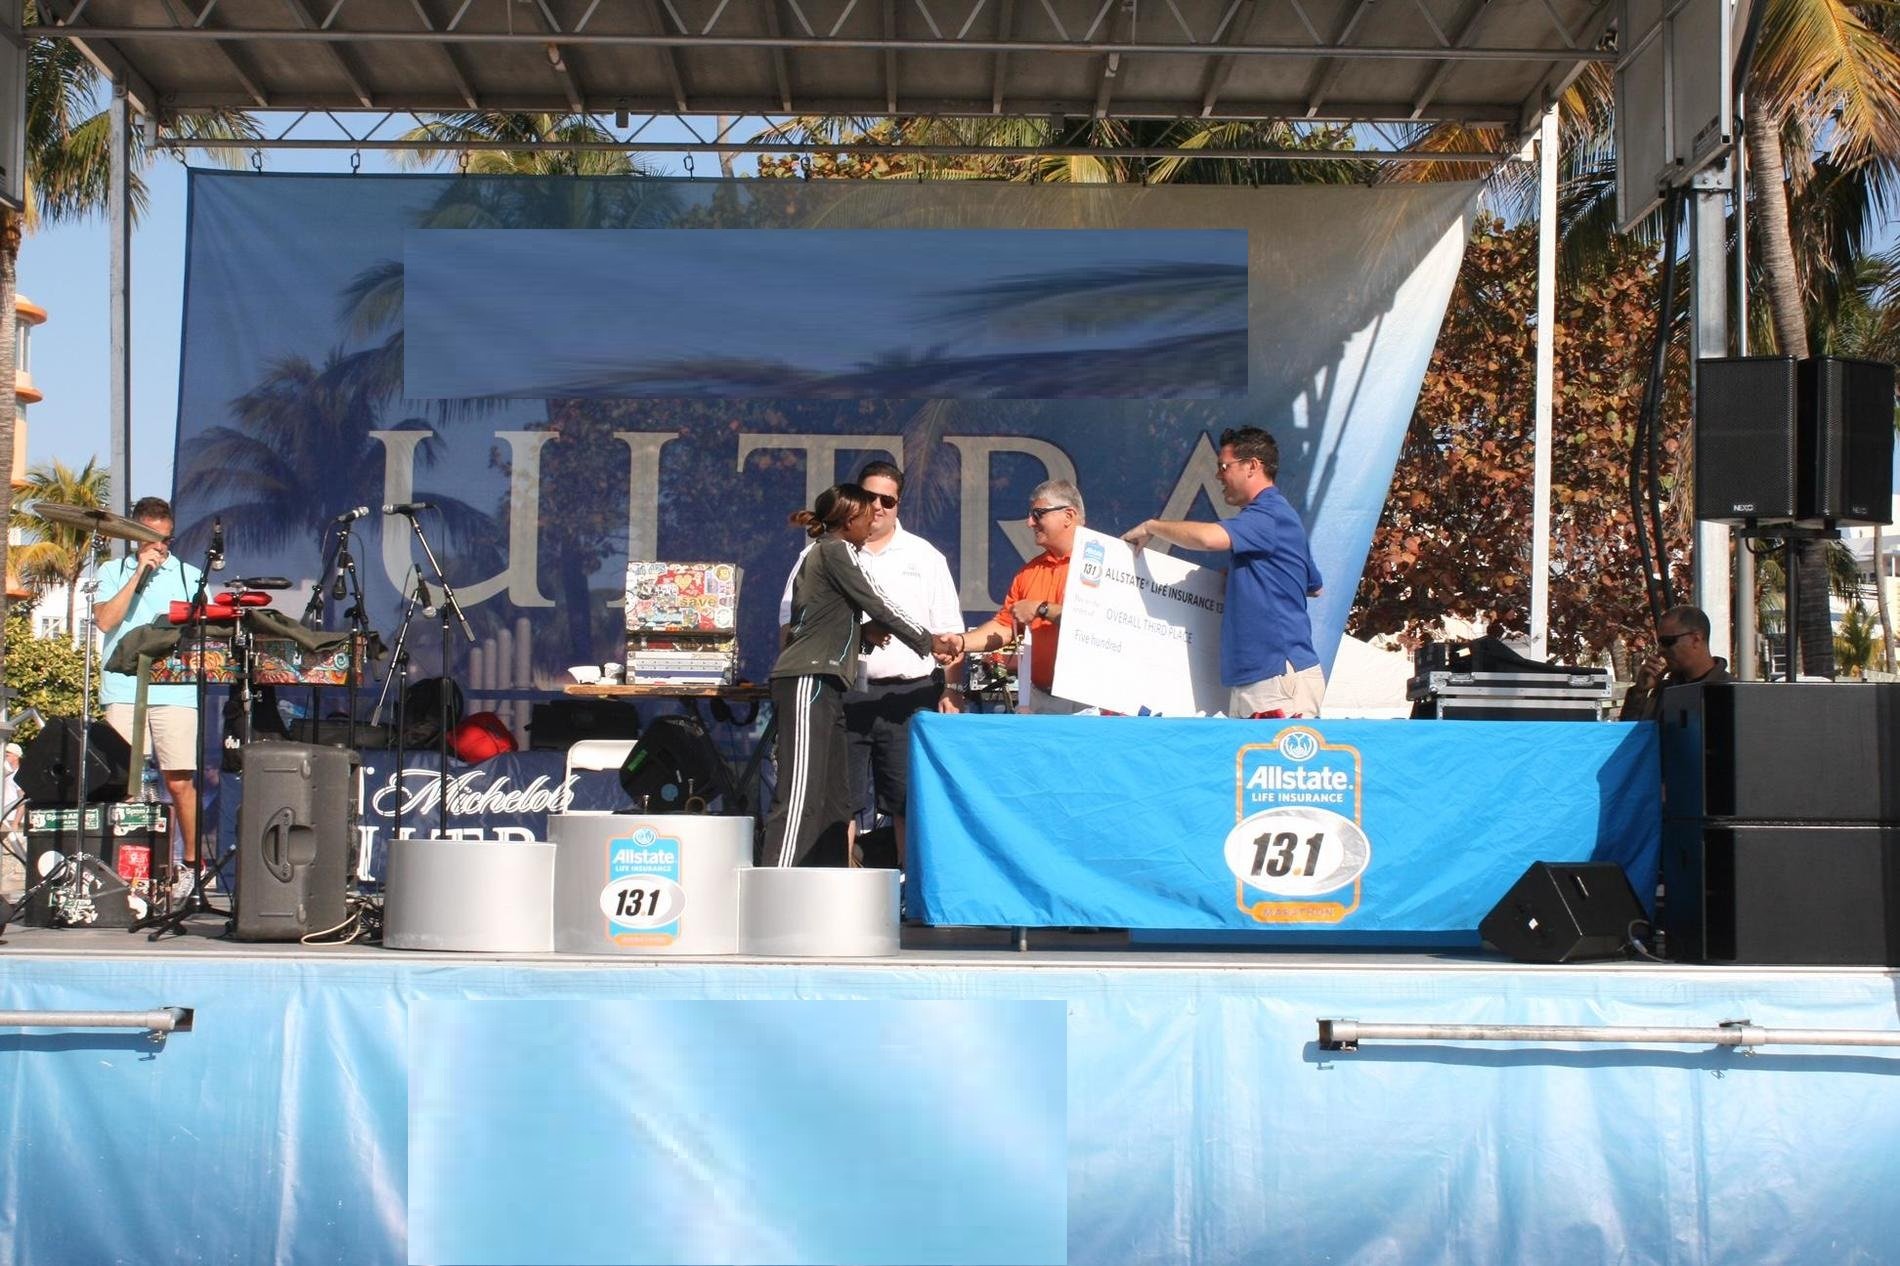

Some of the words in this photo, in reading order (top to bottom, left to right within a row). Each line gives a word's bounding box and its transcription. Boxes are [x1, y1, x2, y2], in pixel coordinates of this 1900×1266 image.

[1151, 581, 1167, 597] LIFE
[1168, 588, 1215, 612] INSURANCE
[1106, 608, 1142, 630] OVERALL
[1144, 619, 1168, 637] THIRD
[372, 768, 581, 817] Michelob
[1252, 793, 1274, 802] LIFE
[1279, 793, 1344, 803] INSURANCE
[615, 865, 629, 873] LIFE
[631, 865, 672, 873] INSURANCE
[1251, 832, 1325, 877] 13.1
